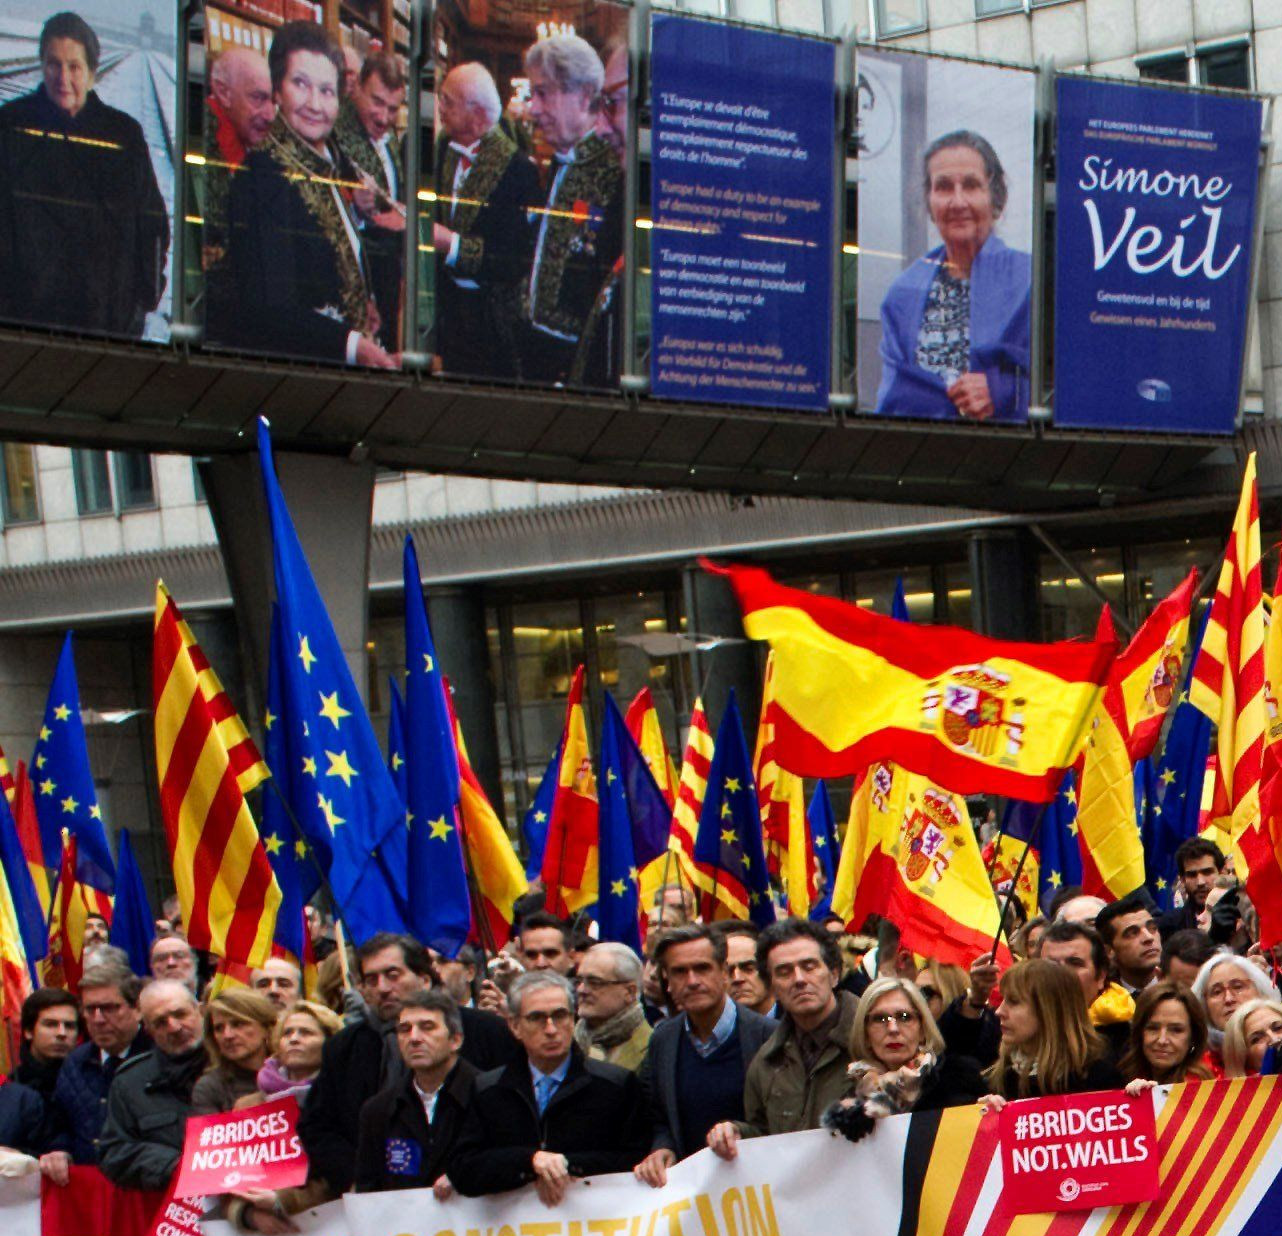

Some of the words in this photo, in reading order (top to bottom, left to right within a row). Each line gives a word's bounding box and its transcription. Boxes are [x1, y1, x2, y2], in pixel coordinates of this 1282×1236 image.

[1079, 155, 1232, 201] Simone
[1083, 199, 1241, 279] Veil
[199, 1111, 289, 1146] #BRIDGES
[1014, 1103, 1132, 1142] #BRIDGES
[191, 1135, 301, 1172] NOT.WALLS
[1011, 1135, 1149, 1175] NOT.WALLS
